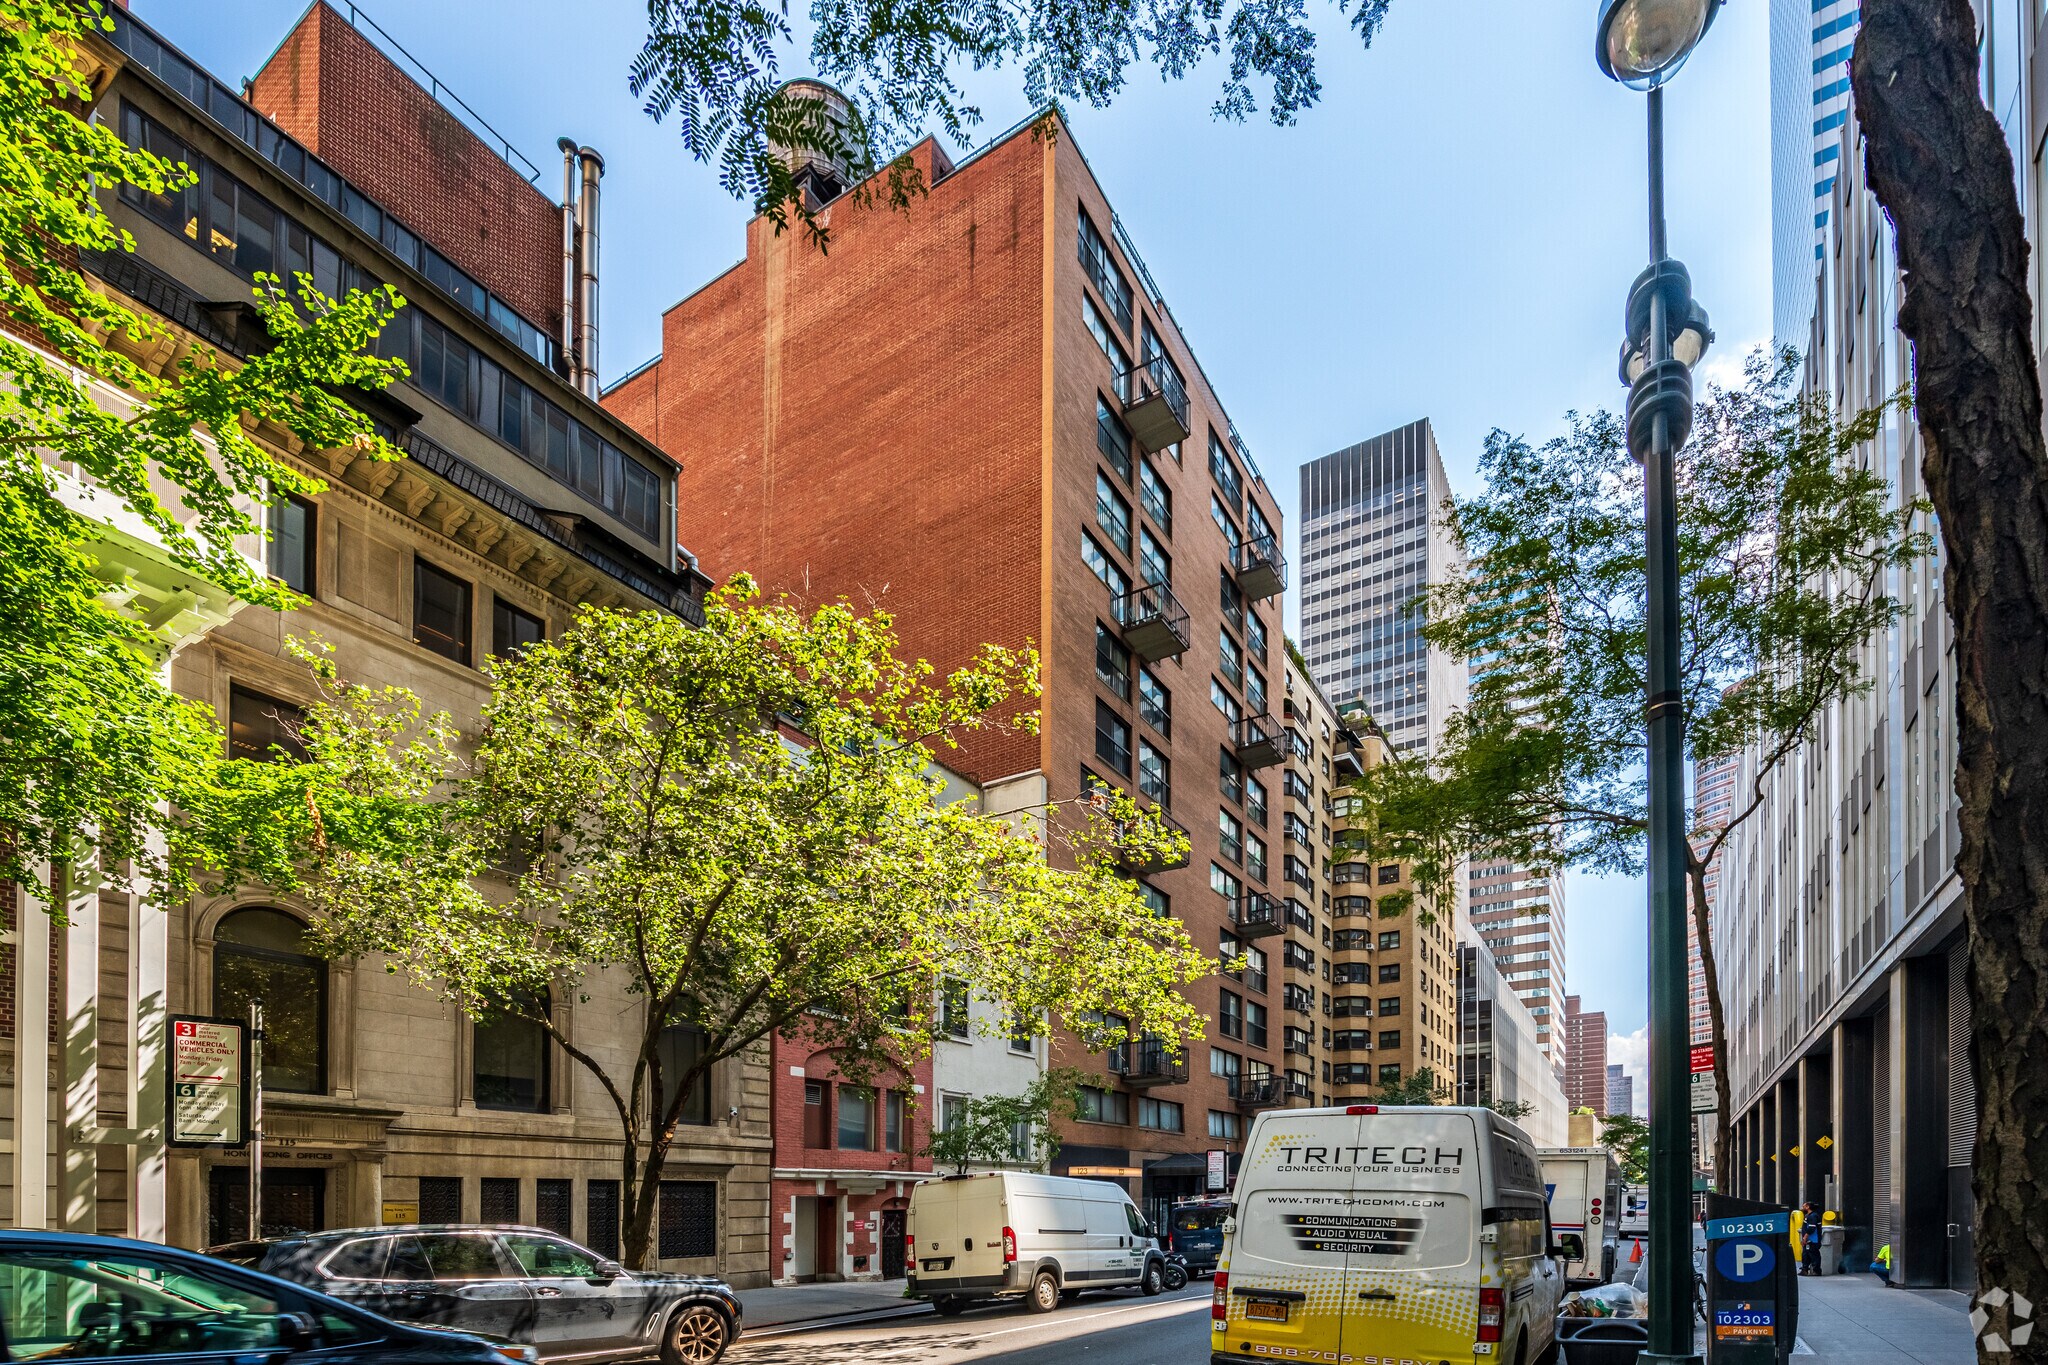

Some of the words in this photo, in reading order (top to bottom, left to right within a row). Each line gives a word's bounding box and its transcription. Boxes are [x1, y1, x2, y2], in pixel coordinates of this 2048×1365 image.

[181, 1024, 192, 1036] 3
[179, 1040, 228, 1048] COMMERCIAL
[1692, 1074, 1698, 1082] 6
[180, 1085, 192, 1096] 6
[296, 1152, 333, 1160] OFFICES
[1280, 1146, 1462, 1166] TRITECH
[1394, 1166, 1460, 1174] BUSINESS
[1268, 1197, 1445, 1208] WWW.TRITECHCOMM.COM
[1306, 1216, 1397, 1227] COMMUNICATIONS
[1722, 1222, 1774, 1234] 102303
[1312, 1229, 1346, 1238] AUDIO
[1349, 1230, 1388, 1240] VISUAL
[1322, 1242, 1374, 1253] SECURITY
[1736, 1244, 1763, 1276] P
[1718, 1315, 1770, 1324] 102303
